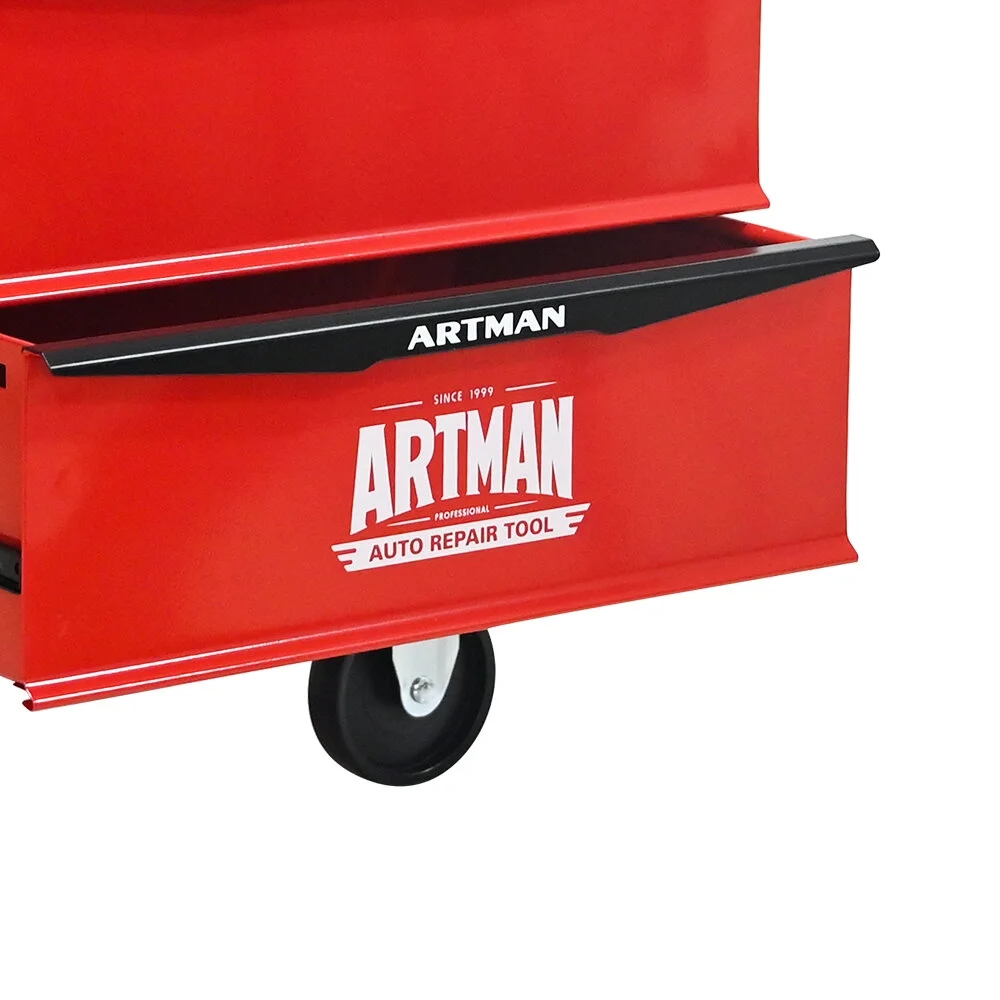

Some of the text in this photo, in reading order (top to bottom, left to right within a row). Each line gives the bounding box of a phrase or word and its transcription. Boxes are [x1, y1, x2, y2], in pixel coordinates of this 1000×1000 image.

[407, 304, 566, 350] ARTMAN
[433, 386, 495, 405] SINCE 1999
[350, 395, 575, 536] ARTMAN
[434, 504, 490, 522] PROFESSIONAL
[369, 516, 554, 562] AUTO REPAIR TOOL
